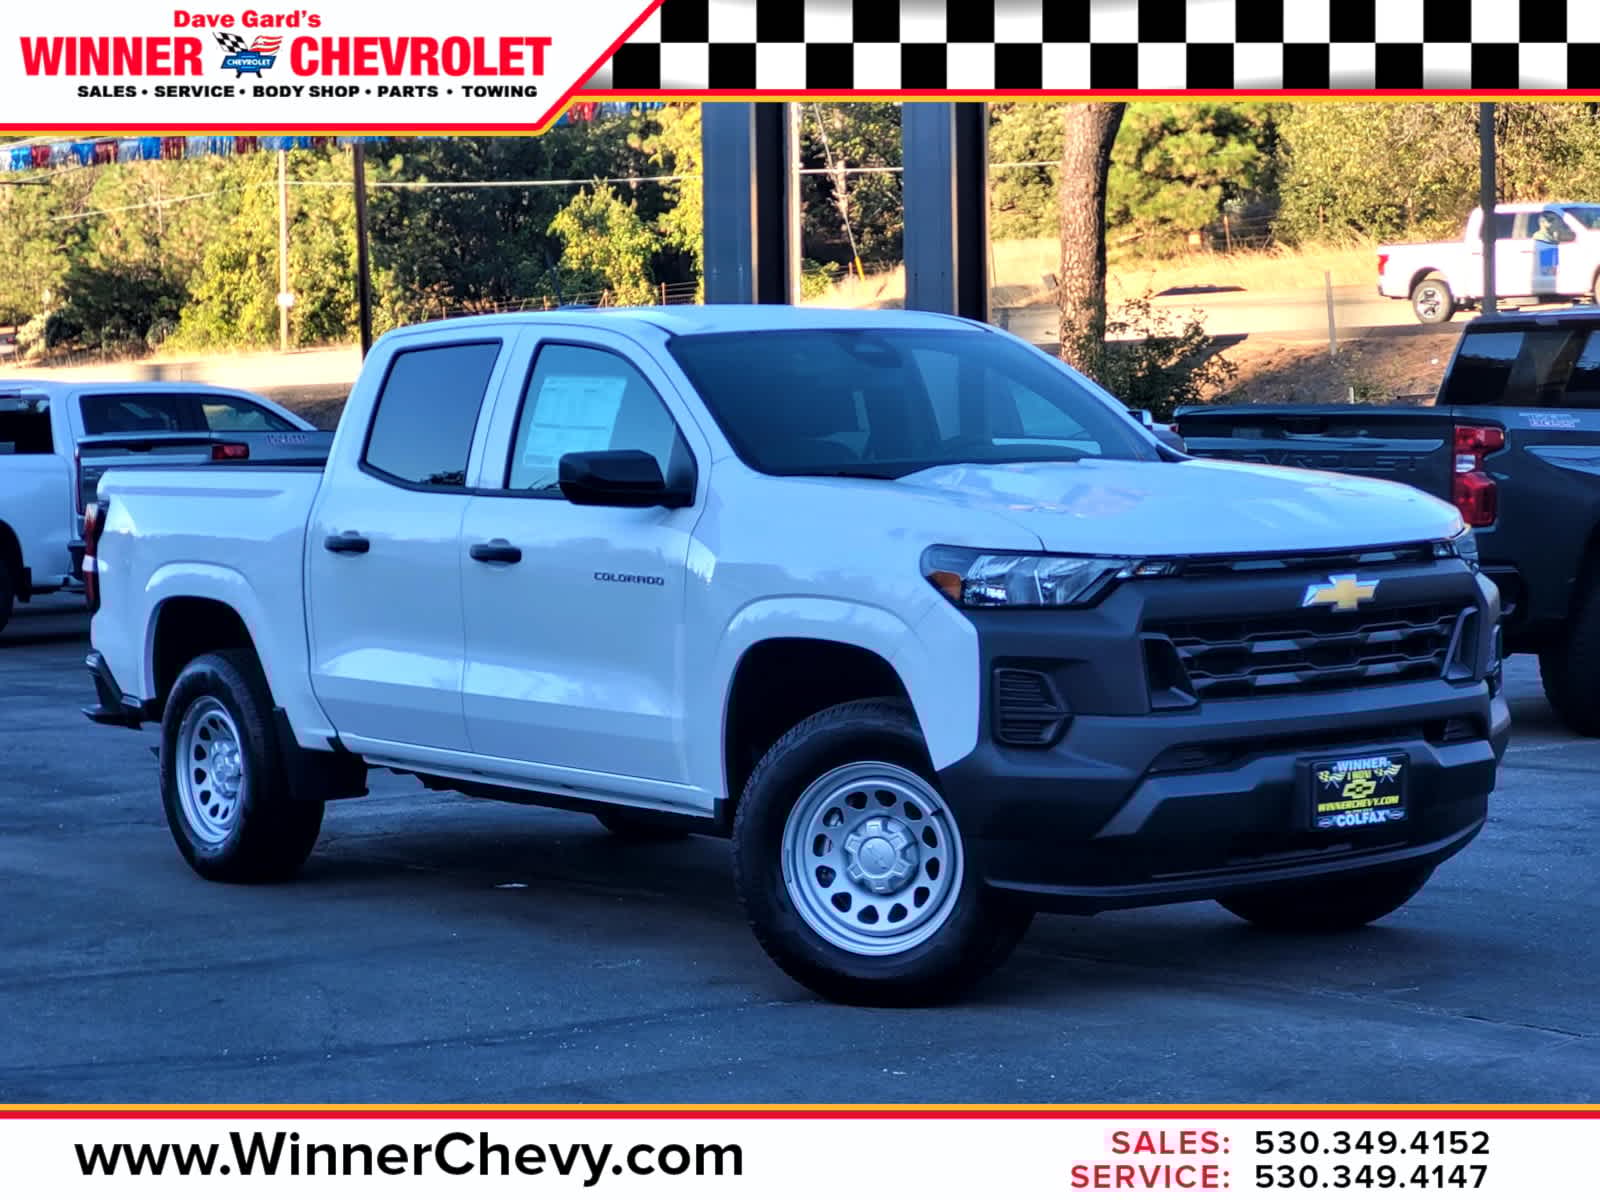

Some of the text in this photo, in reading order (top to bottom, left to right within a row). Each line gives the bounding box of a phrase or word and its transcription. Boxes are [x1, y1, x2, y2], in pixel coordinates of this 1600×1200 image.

[593, 571, 665, 587] COLORADO
[1336, 756, 1388, 772] WINNER
[1317, 795, 1400, 812] WINNERCHEVY.COM
[1336, 810, 1387, 827] COLFAX
